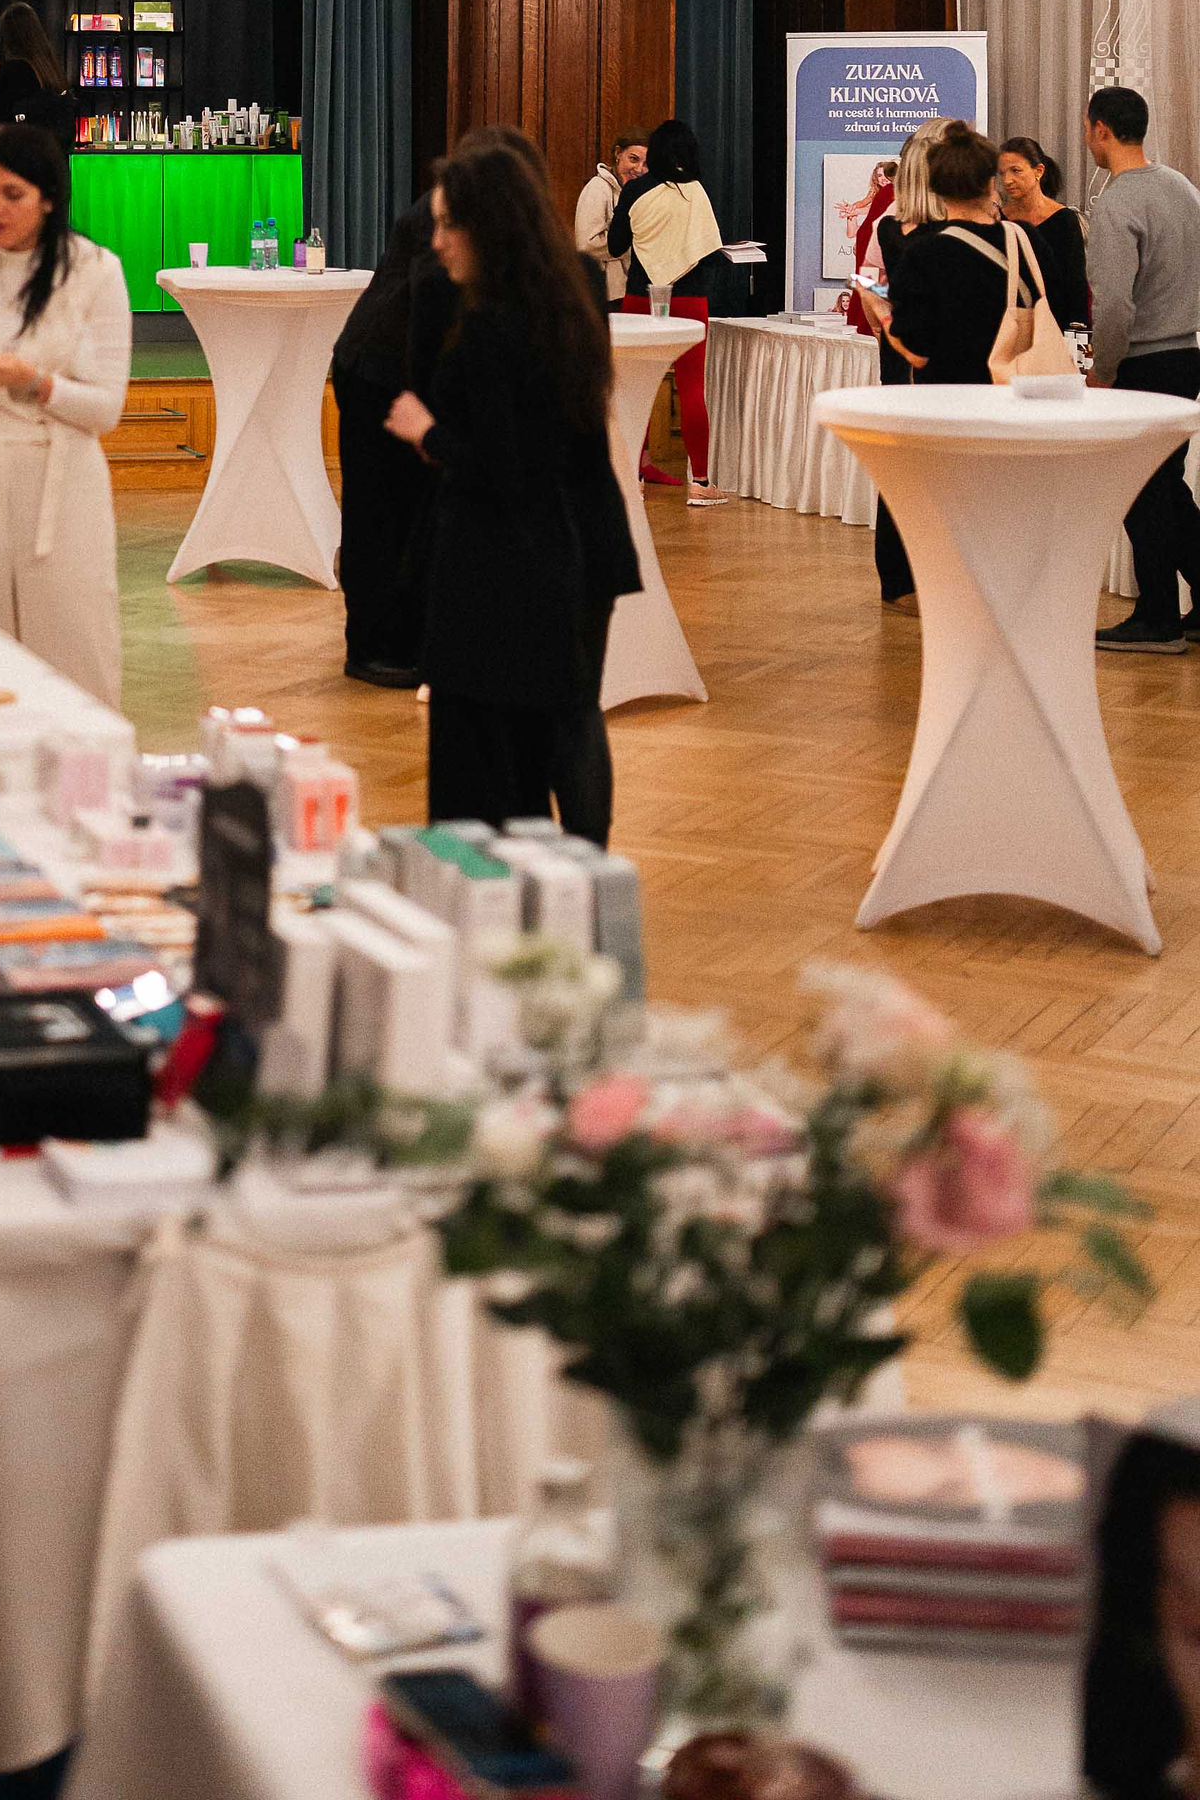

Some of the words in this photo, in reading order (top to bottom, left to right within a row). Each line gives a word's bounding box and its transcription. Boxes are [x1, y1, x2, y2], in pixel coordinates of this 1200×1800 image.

[845, 64, 924, 80] ZUZANA
[830, 83, 940, 103] KLINGROVÁ
[828, 109, 843, 118] na
[845, 107, 874, 118] cestě
[876, 107, 884, 118] k
[844, 122, 880, 133] zdraví
[882, 124, 890, 133] a
